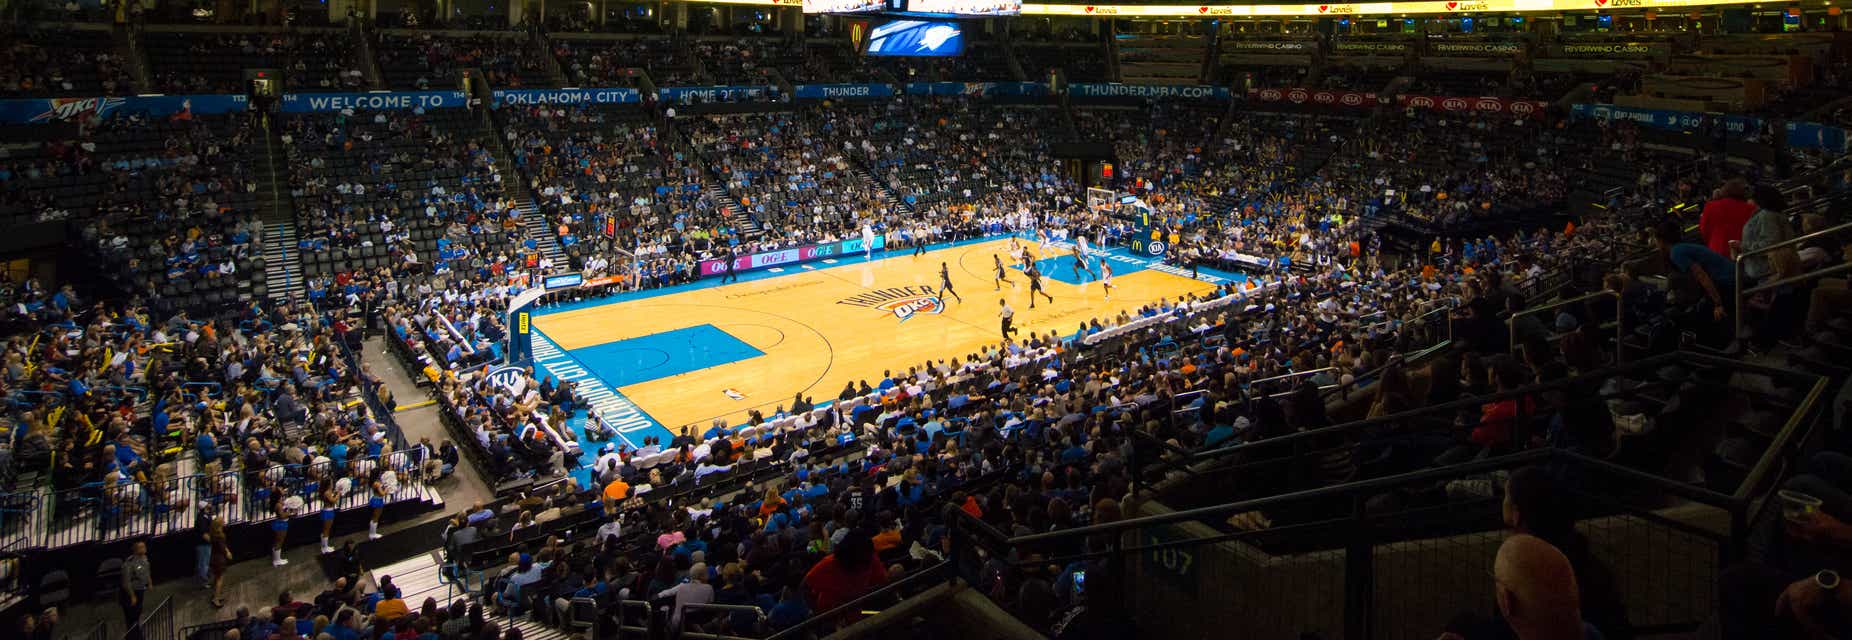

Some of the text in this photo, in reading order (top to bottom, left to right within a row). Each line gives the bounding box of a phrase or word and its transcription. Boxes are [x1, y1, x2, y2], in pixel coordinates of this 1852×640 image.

[506, 91, 628, 105] OKLAHOMA CITY
[823, 87, 870, 96] THUNDER
[1084, 85, 1213, 97] THUNDER.NBA.COM
[310, 95, 443, 109] WELCOME TO
[835, 285, 938, 308] THUNDER
[520, 314, 528, 331] Hertz
[542, 360, 588, 381] CITY
